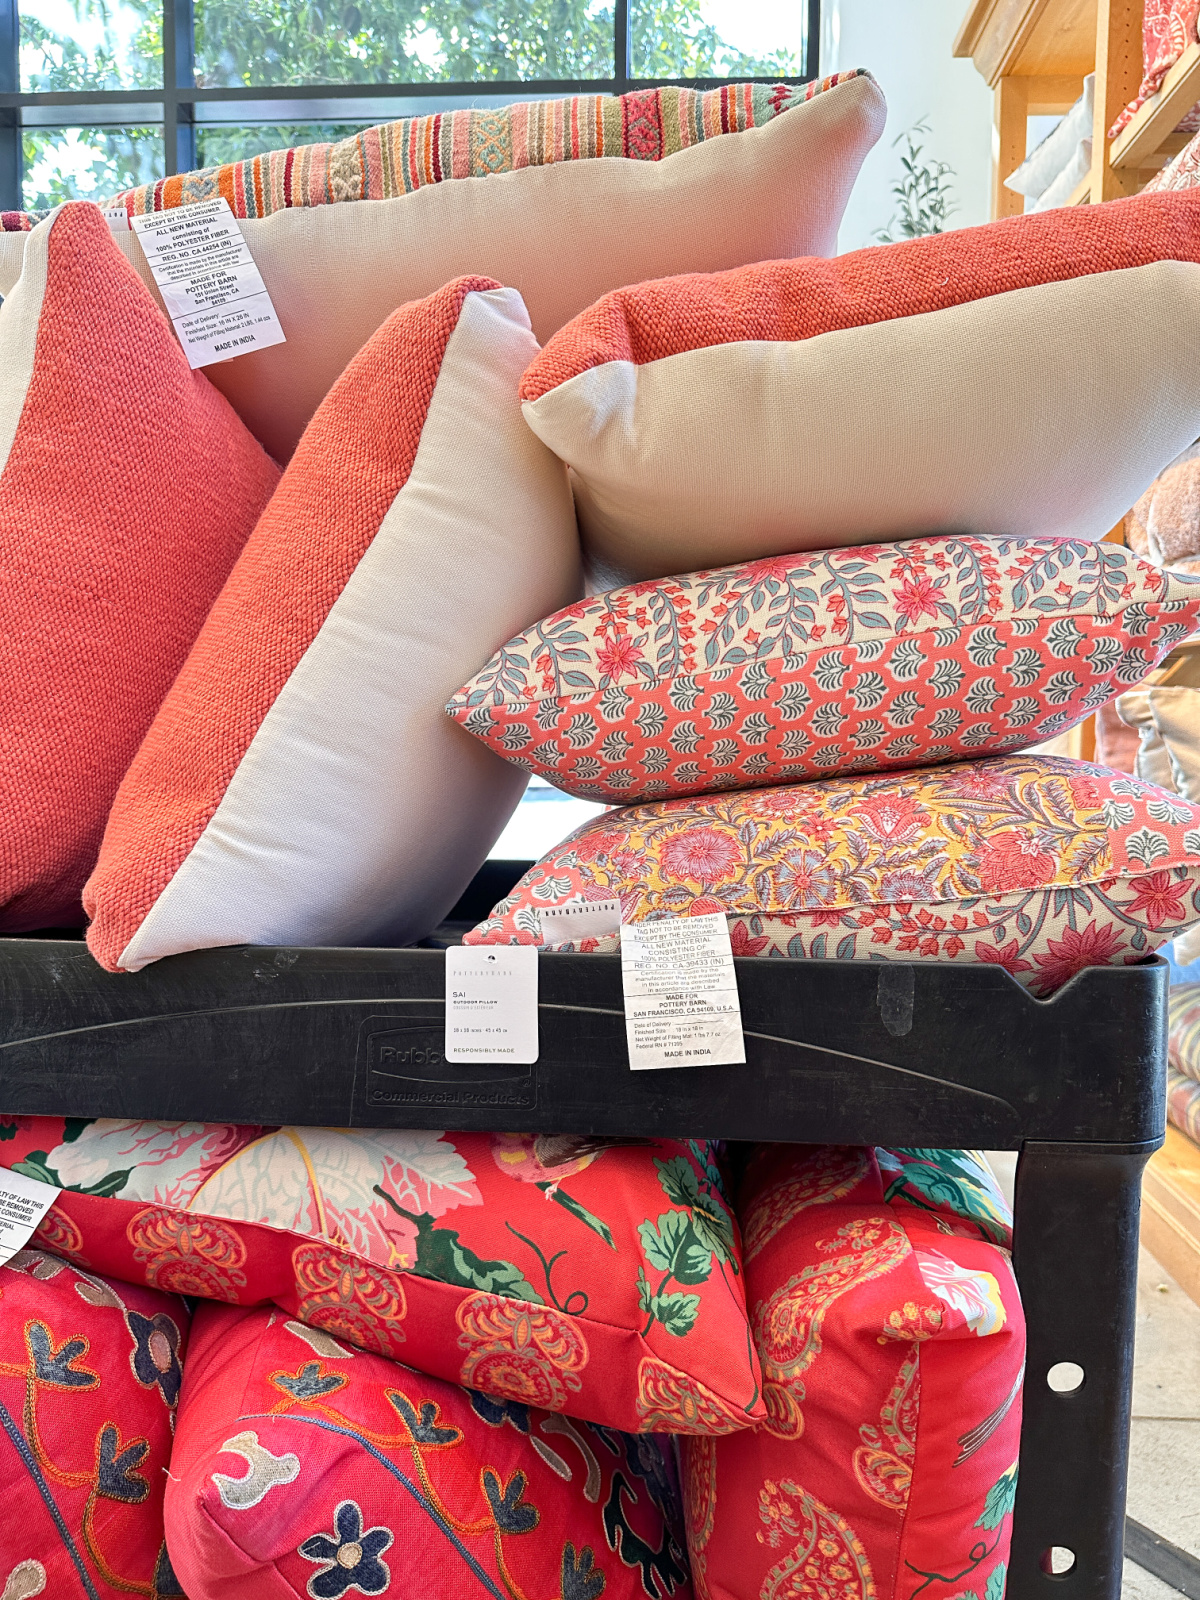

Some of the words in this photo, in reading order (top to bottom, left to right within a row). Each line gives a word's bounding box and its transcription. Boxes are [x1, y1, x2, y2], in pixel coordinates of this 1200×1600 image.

[144, 219, 166, 229] EXCEPT
[189, 207, 220, 218] CONSUMER
[170, 224, 184, 233] NEW
[185, 216, 218, 229] MATERIAL
[172, 229, 202, 240] consisting
[173, 235, 210, 248] POLYESTER
[211, 229, 230, 239] FIBER
[202, 243, 220, 252] 44254
[221, 240, 231, 248] (IN)
[190, 275, 210, 286] MADE
[212, 270, 227, 279] FOR
[185, 281, 216, 294] POTTERY
[218, 275, 237, 286] BARN
[204, 288, 218, 296] Union
[219, 283, 234, 292] Street
[185, 327, 206, 336] Finished
[214, 341, 232, 352] MADE
[240, 334, 256, 344] INDIA
[682, 929, 718, 937] CONSUMER
[674, 936, 711, 946] MATERIAL
[648, 946, 695, 956] CONSISTING
[658, 953, 695, 962] POLYESTER
[372, 1090, 459, 1104] Commercial
[462, 1092, 529, 1105] Products
[6, 1202, 34, 1214] REMOVED
[17, 1197, 31, 1205] LAW
[31, 1200, 44, 1209] THIS
[1, 1209, 32, 1222] CONSUMER
